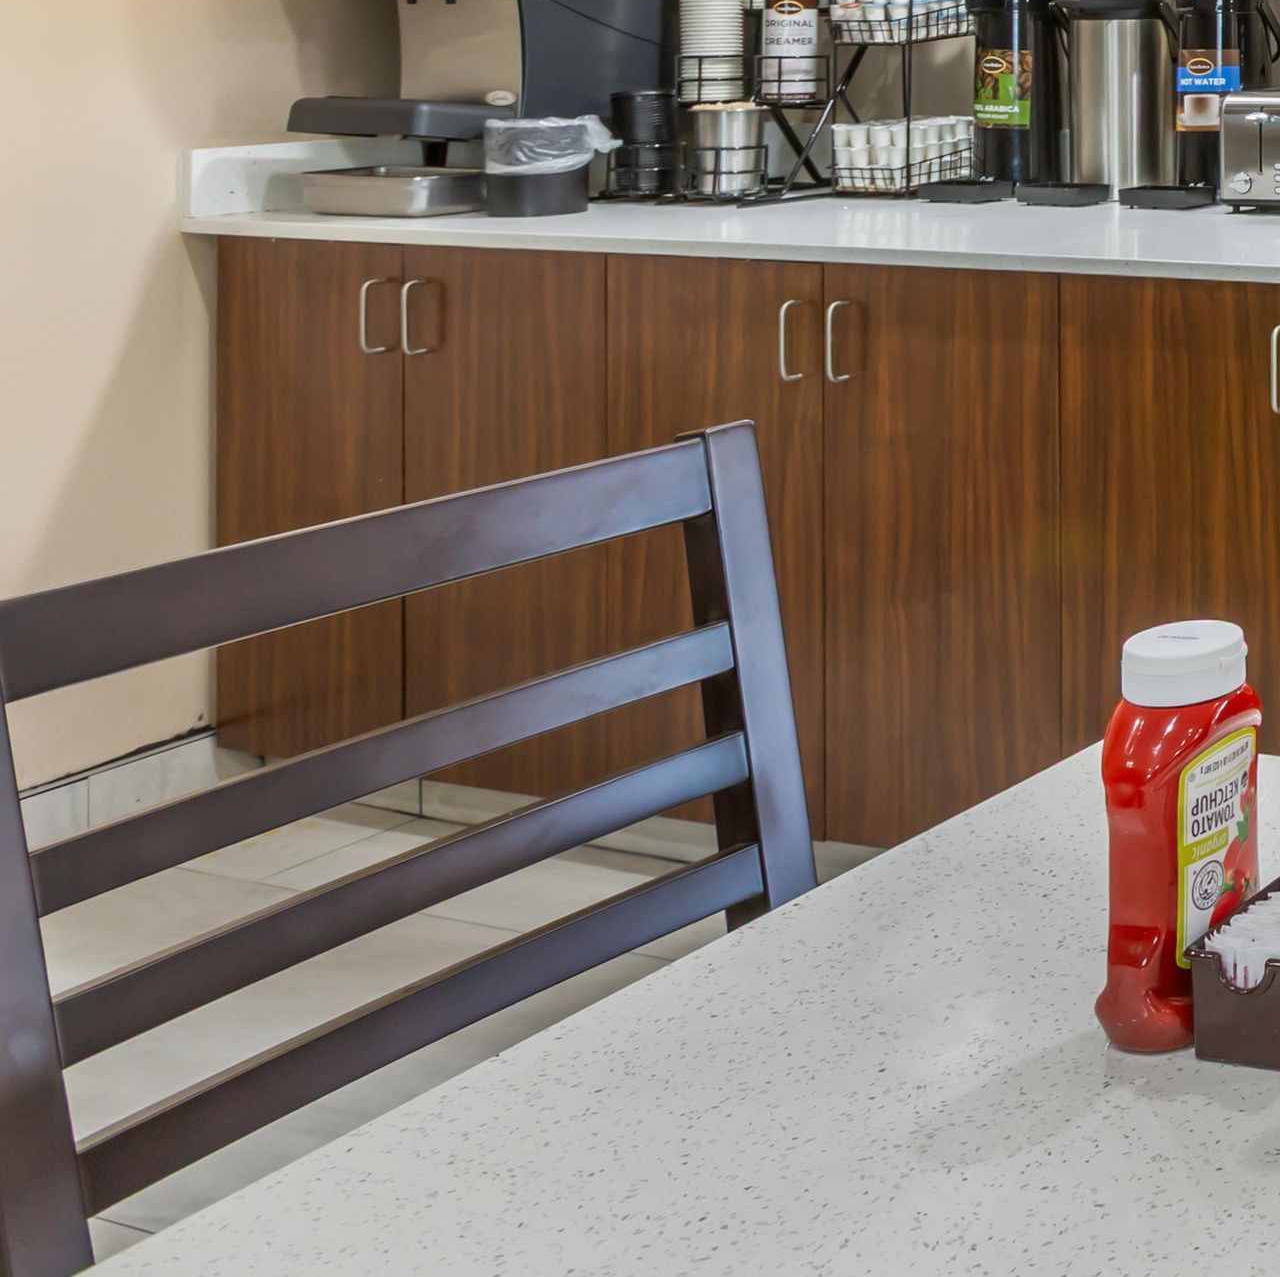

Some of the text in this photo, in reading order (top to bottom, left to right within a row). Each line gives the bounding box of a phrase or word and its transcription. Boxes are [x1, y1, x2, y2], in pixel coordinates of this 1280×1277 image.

[1193, 77, 1226, 86] WATER
[984, 104, 1020, 113] ARABICA
[1191, 778, 1239, 817] KETCHUP
[1191, 801, 1235, 838] TOMATO
[1191, 832, 1227, 861] organic
